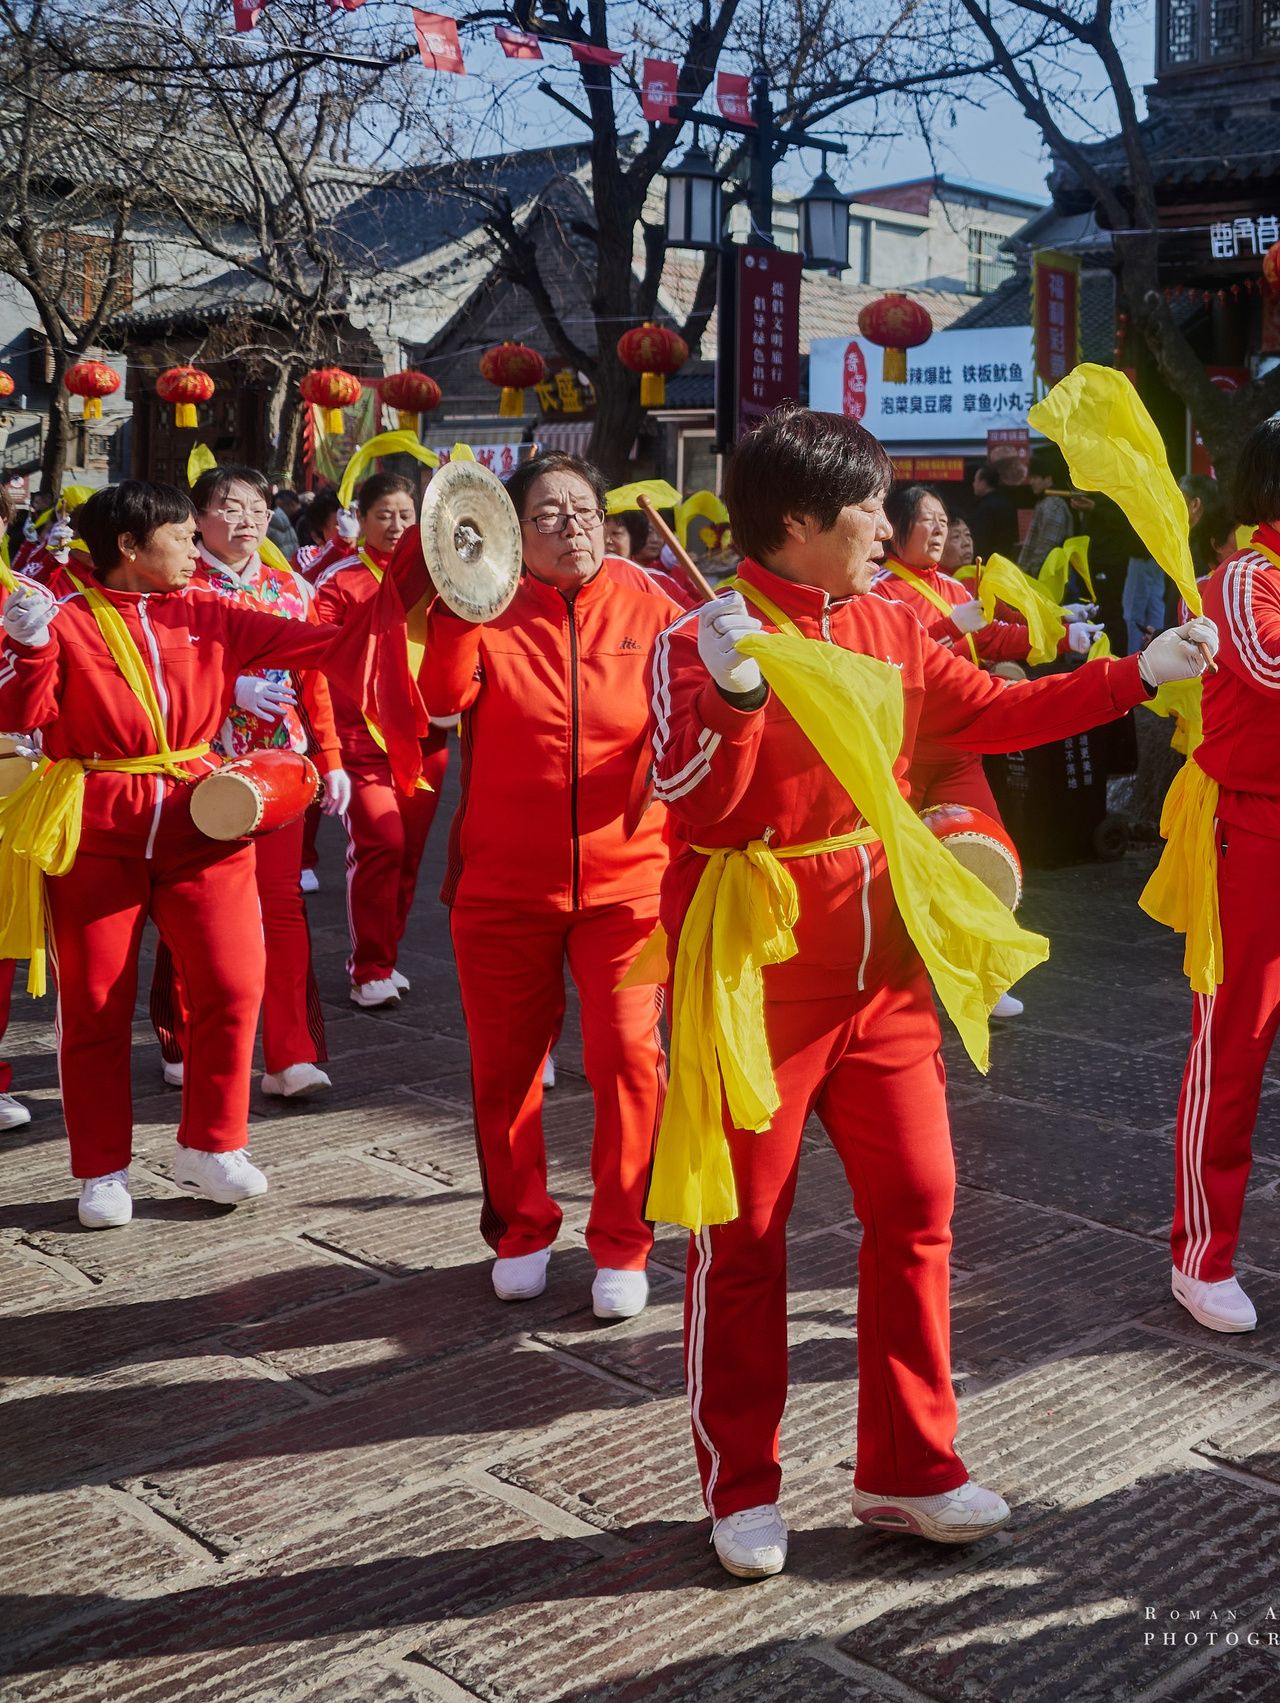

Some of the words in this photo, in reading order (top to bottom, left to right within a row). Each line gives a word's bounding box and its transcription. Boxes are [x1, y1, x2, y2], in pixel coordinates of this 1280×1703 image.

[753, 295, 766, 397] 倡导绿色出行
[770, 281, 784, 382] 提倡文明旅行
[962, 362, 1024, 384] 铁板鱿鱼
[880, 393, 953, 415] 泡菜臭豆腐
